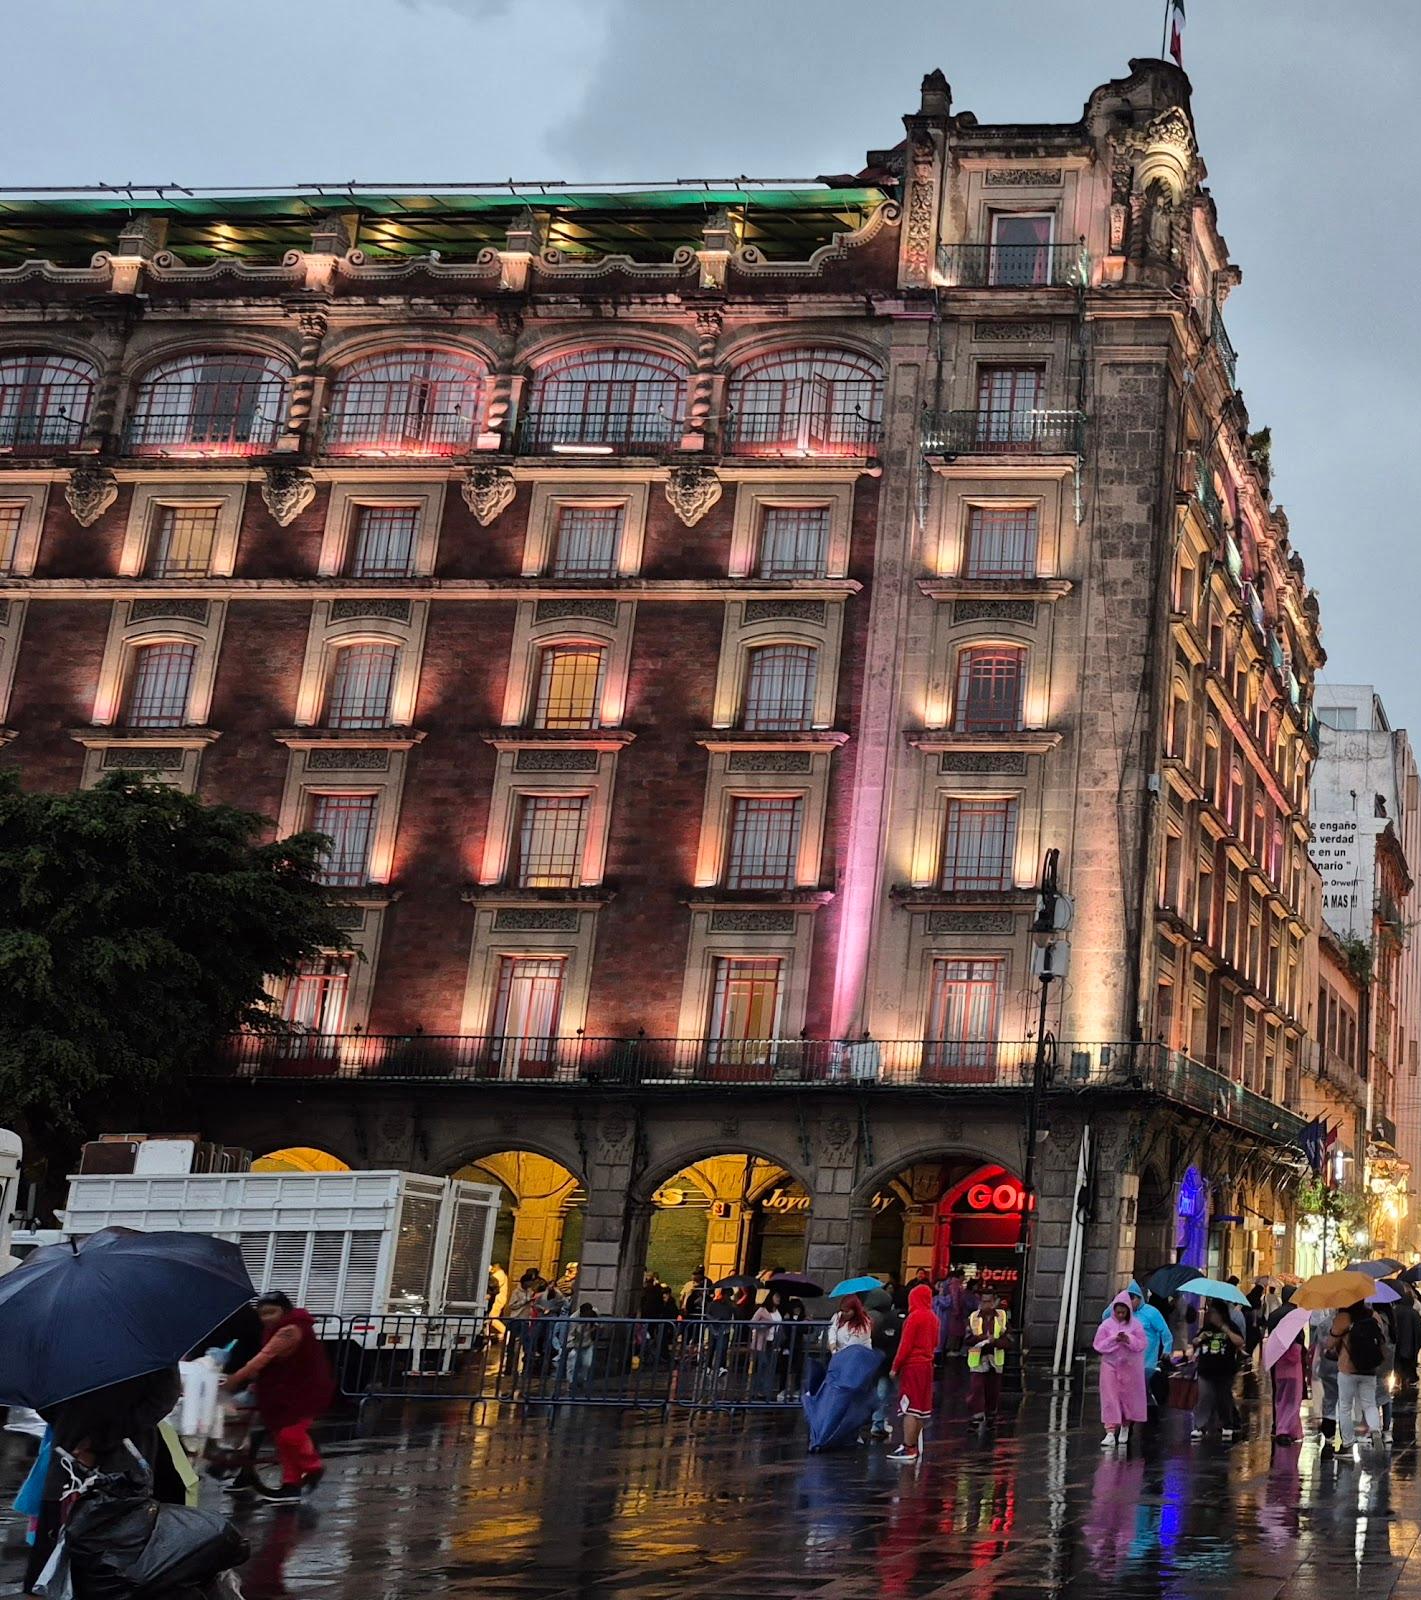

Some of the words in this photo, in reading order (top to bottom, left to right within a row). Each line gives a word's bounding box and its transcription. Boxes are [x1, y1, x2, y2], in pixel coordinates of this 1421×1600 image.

[1320, 821, 1357, 832] engaño
[1320, 834, 1354, 844] verdad
[1318, 849, 1331, 857] en
[1334, 849, 1346, 857] un
[1315, 861, 1344, 871] nario
[1331, 894, 1349, 909] MAS
